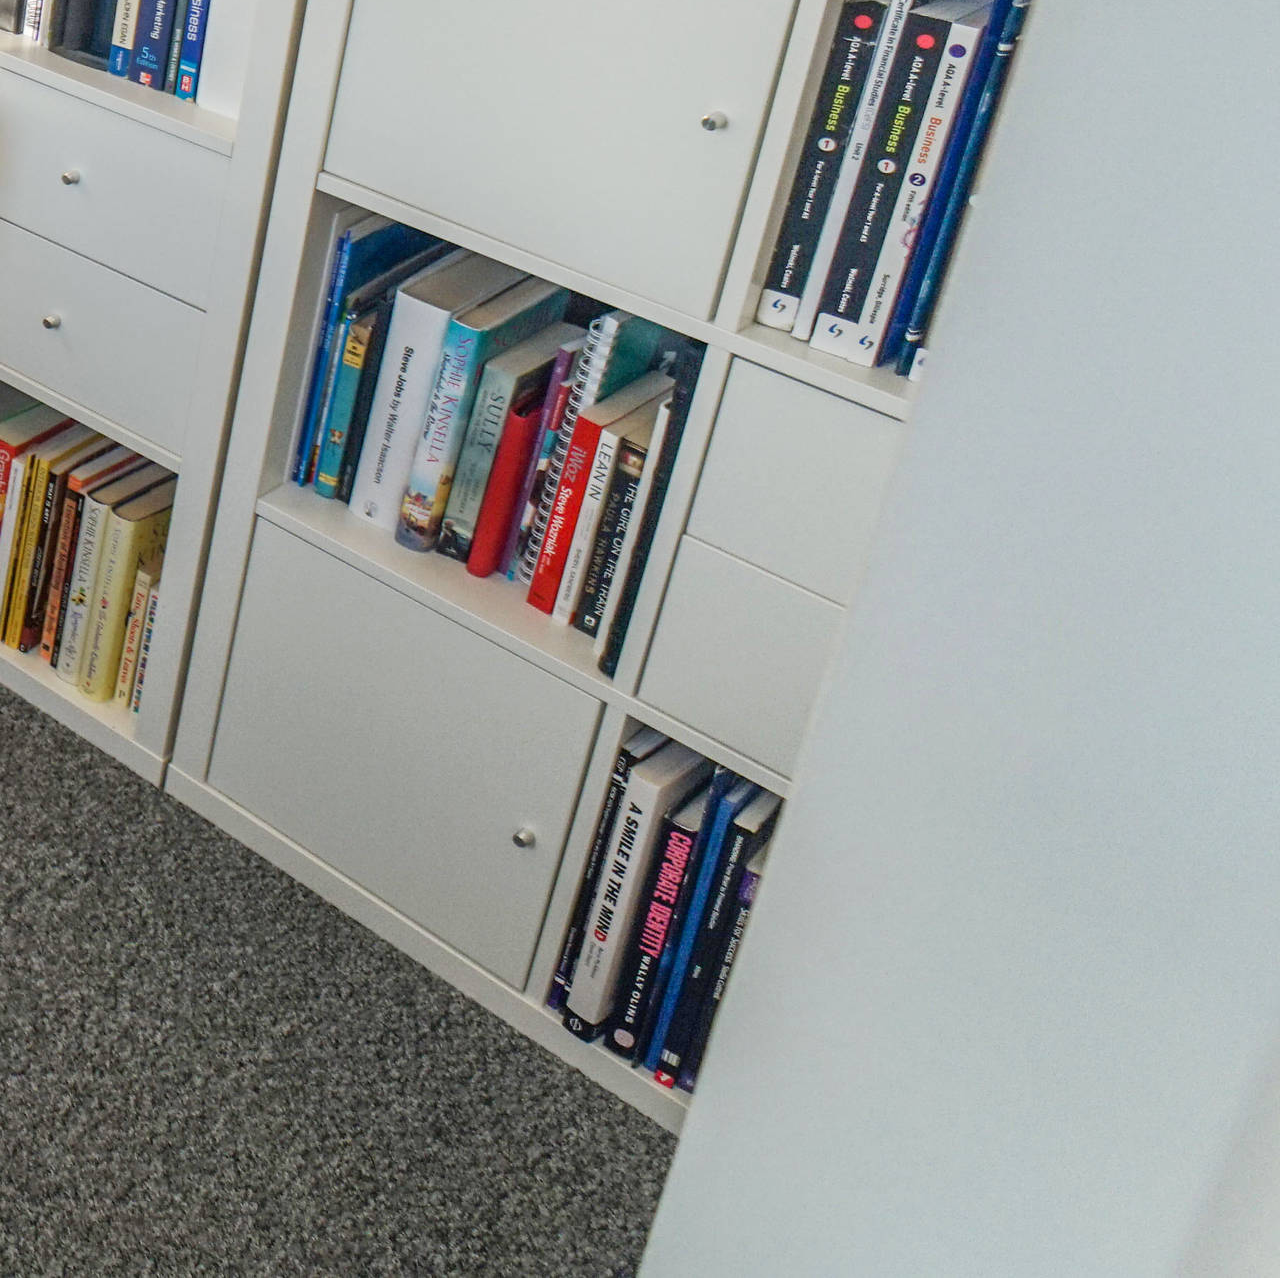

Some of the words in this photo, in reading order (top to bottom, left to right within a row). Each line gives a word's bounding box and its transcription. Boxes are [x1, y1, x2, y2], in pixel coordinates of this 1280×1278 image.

[886, 36, 895, 44] in
[840, 53, 856, 80] A-level
[876, 45, 893, 78] Financial
[910, 55, 923, 72] AQA
[944, 63, 955, 79] AQA
[868, 79, 882, 106] Studies
[901, 73, 918, 101] A-level
[935, 80, 950, 108] A-level
[825, 84, 850, 130] Business
[885, 105, 910, 152] Business
[917, 117, 942, 163] Business
[875, 182, 884, 192] For
[399, 346, 413, 373] Steve
[446, 334, 473, 389] SOPHIE
[393, 374, 406, 397] Jobs
[389, 399, 400, 411] by
[384, 413, 397, 441] Walter
[427, 395, 458, 462] KINSELLA
[477, 395, 502, 453] SULLY
[374, 443, 390, 483] Isaacson
[564, 446, 585, 481] iWoz
[593, 442, 612, 482] LEAN
[555, 485, 572, 513] Steve
[588, 483, 602, 500] IN
[624, 482, 638, 503] THE
[85, 507, 98, 537] SOPHIE
[601, 492, 619, 532] PAULA
[616, 507, 631, 534] GIRL
[544, 514, 563, 555] Wozniak
[609, 537, 623, 555] ON
[77, 538, 93, 582] KINSELLA
[584, 539, 606, 593] HAWKINS
[603, 558, 616, 580] THE
[593, 583, 609, 615] TRAIN
[128, 618, 139, 644] Shoots
[628, 802, 642, 814] A
[617, 816, 638, 858] SMILE
[611, 859, 626, 877] IN
[654, 832, 690, 901] CORPORATE
[604, 878, 621, 905] THE
[594, 905, 613, 941] MIND
[640, 901, 670, 956] IDENTITY
[731, 926, 744, 937] for
[724, 936, 739, 962] Success
[635, 955, 650, 989] WALLY
[624, 990, 640, 1023] OLINS
